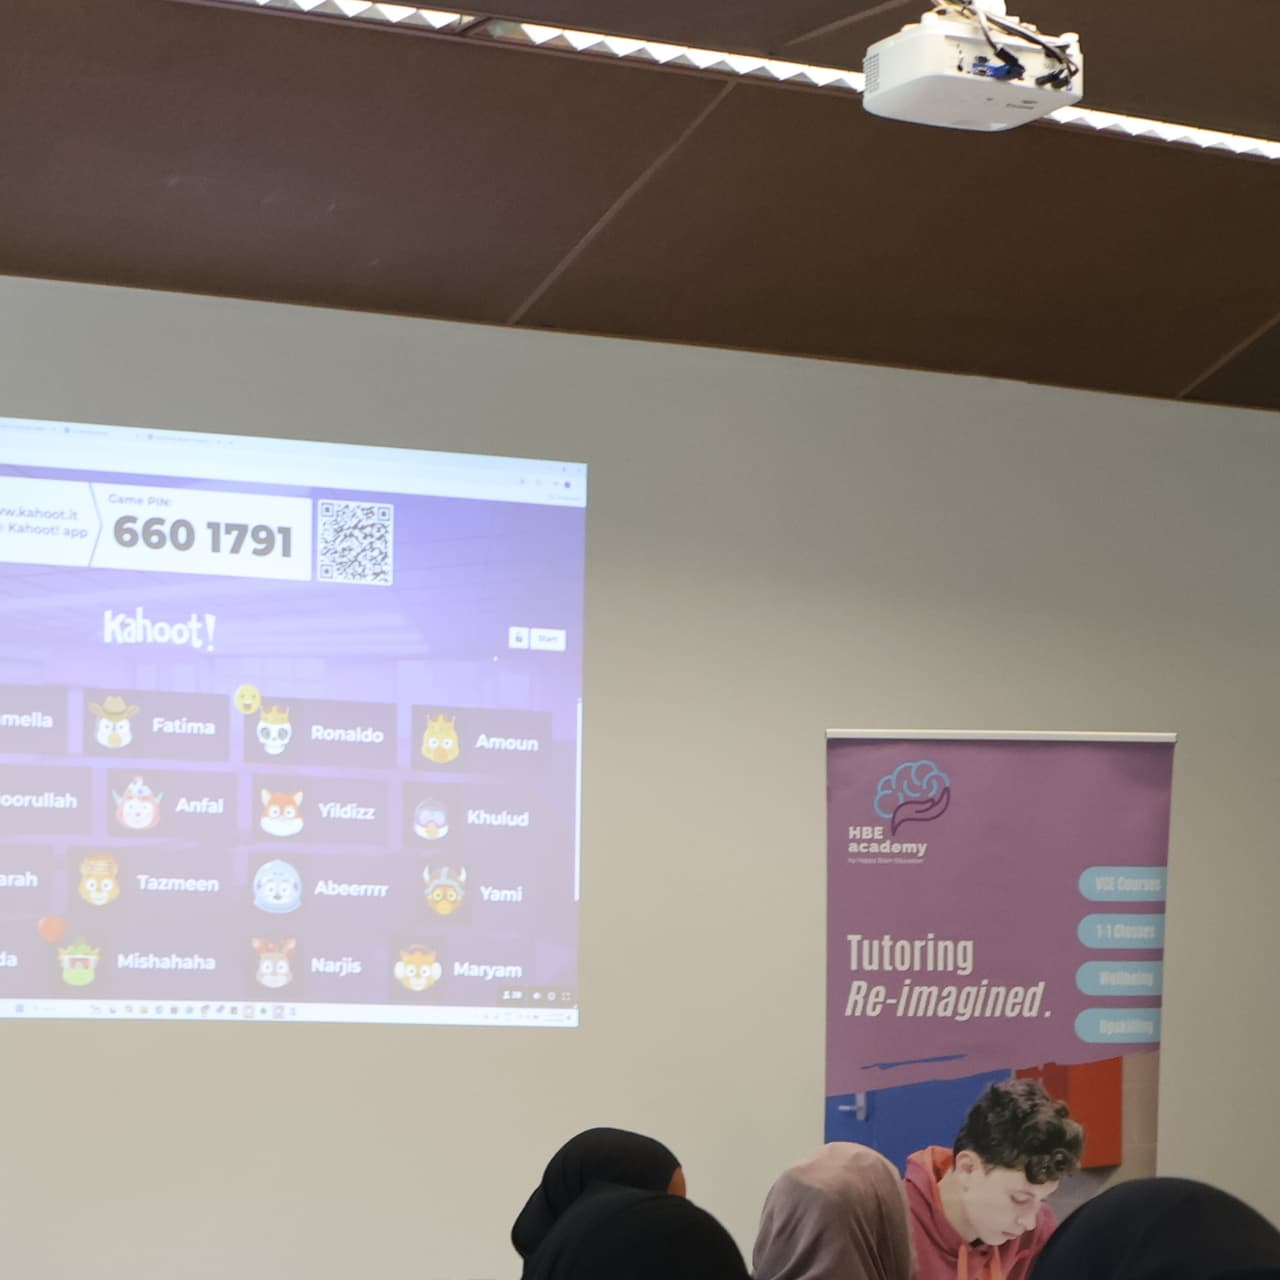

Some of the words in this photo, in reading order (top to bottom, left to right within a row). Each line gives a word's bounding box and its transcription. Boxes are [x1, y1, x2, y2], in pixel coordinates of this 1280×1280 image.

[108, 493, 144, 506] Game
[62, 527, 88, 539] app
[113, 515, 195, 551] 660
[206, 521, 292, 557] 1791
[103, 606, 217, 652] Kahoot!
[152, 717, 216, 735] Fatima
[311, 724, 384, 743] Ronaldo
[475, 733, 539, 751] Amoun
[318, 802, 375, 820] Yildizz
[848, 826, 884, 839] HBE
[847, 839, 928, 857] academy
[136, 874, 219, 892] Tazmeen
[479, 886, 523, 902] Yami
[117, 952, 216, 970] Mishahaha
[847, 932, 974, 976] Tutoring
[311, 957, 362, 977] Narjis
[453, 961, 522, 981] Maryam
[844, 978, 1052, 1022] Re-imagined.
